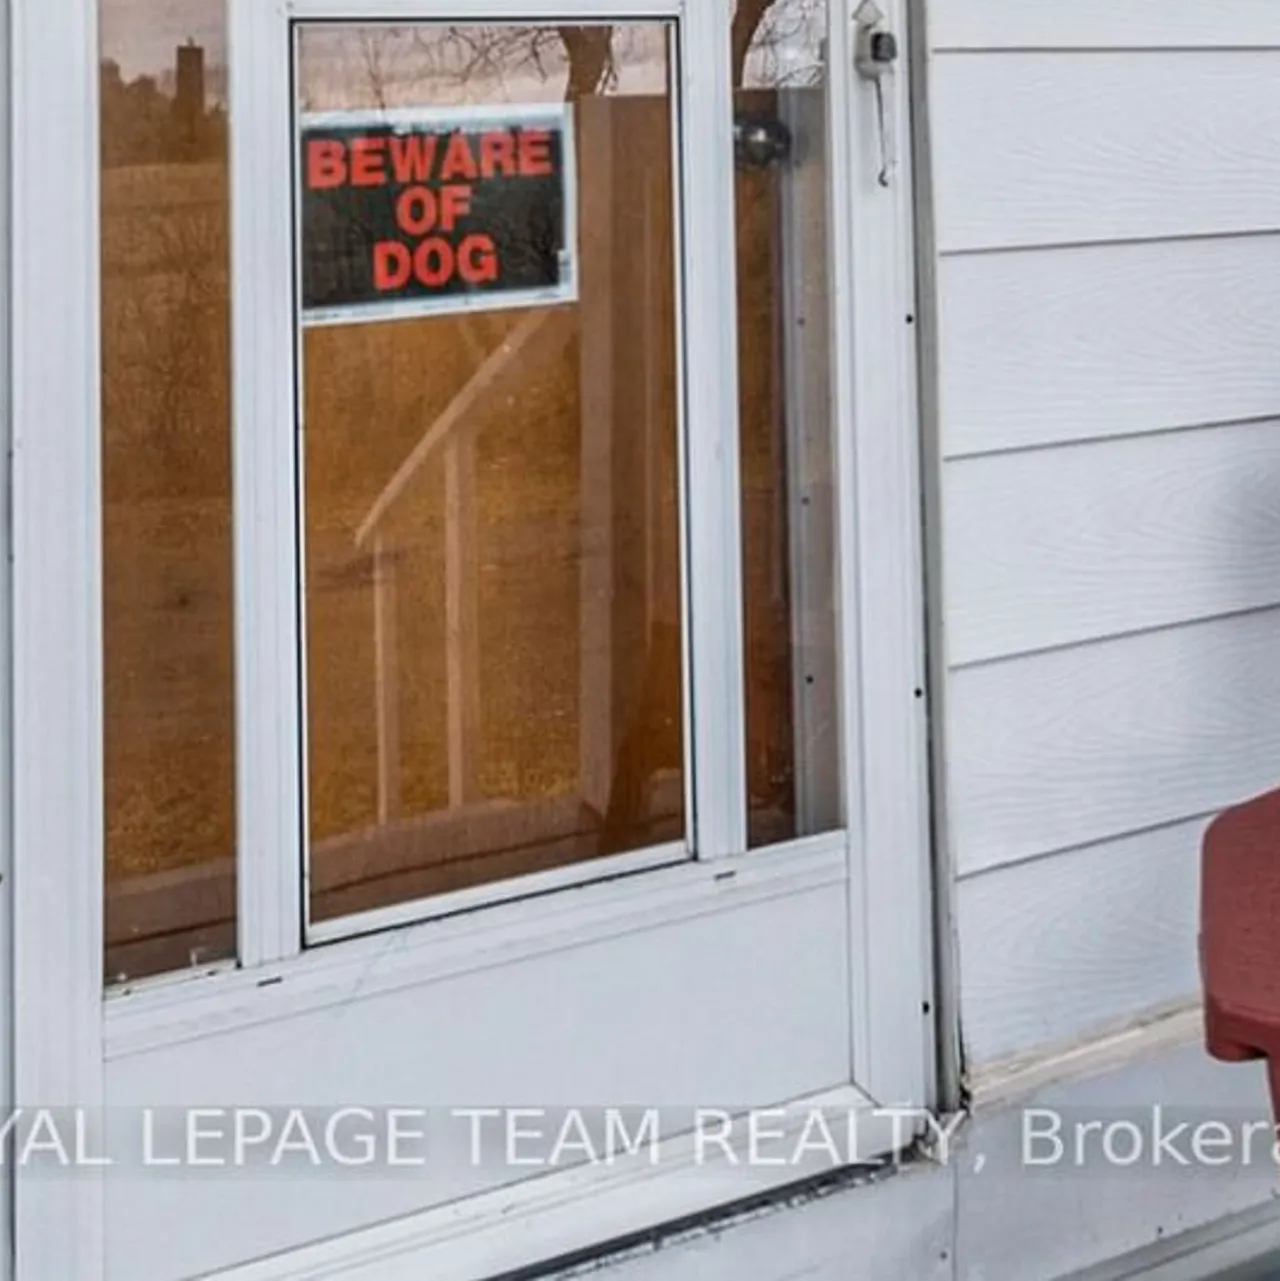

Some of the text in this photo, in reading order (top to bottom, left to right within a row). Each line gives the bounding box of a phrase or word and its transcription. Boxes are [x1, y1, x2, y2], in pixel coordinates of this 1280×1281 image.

[307, 126, 554, 189] BEWARE
[396, 184, 473, 235] OF
[373, 233, 498, 290] DOG
